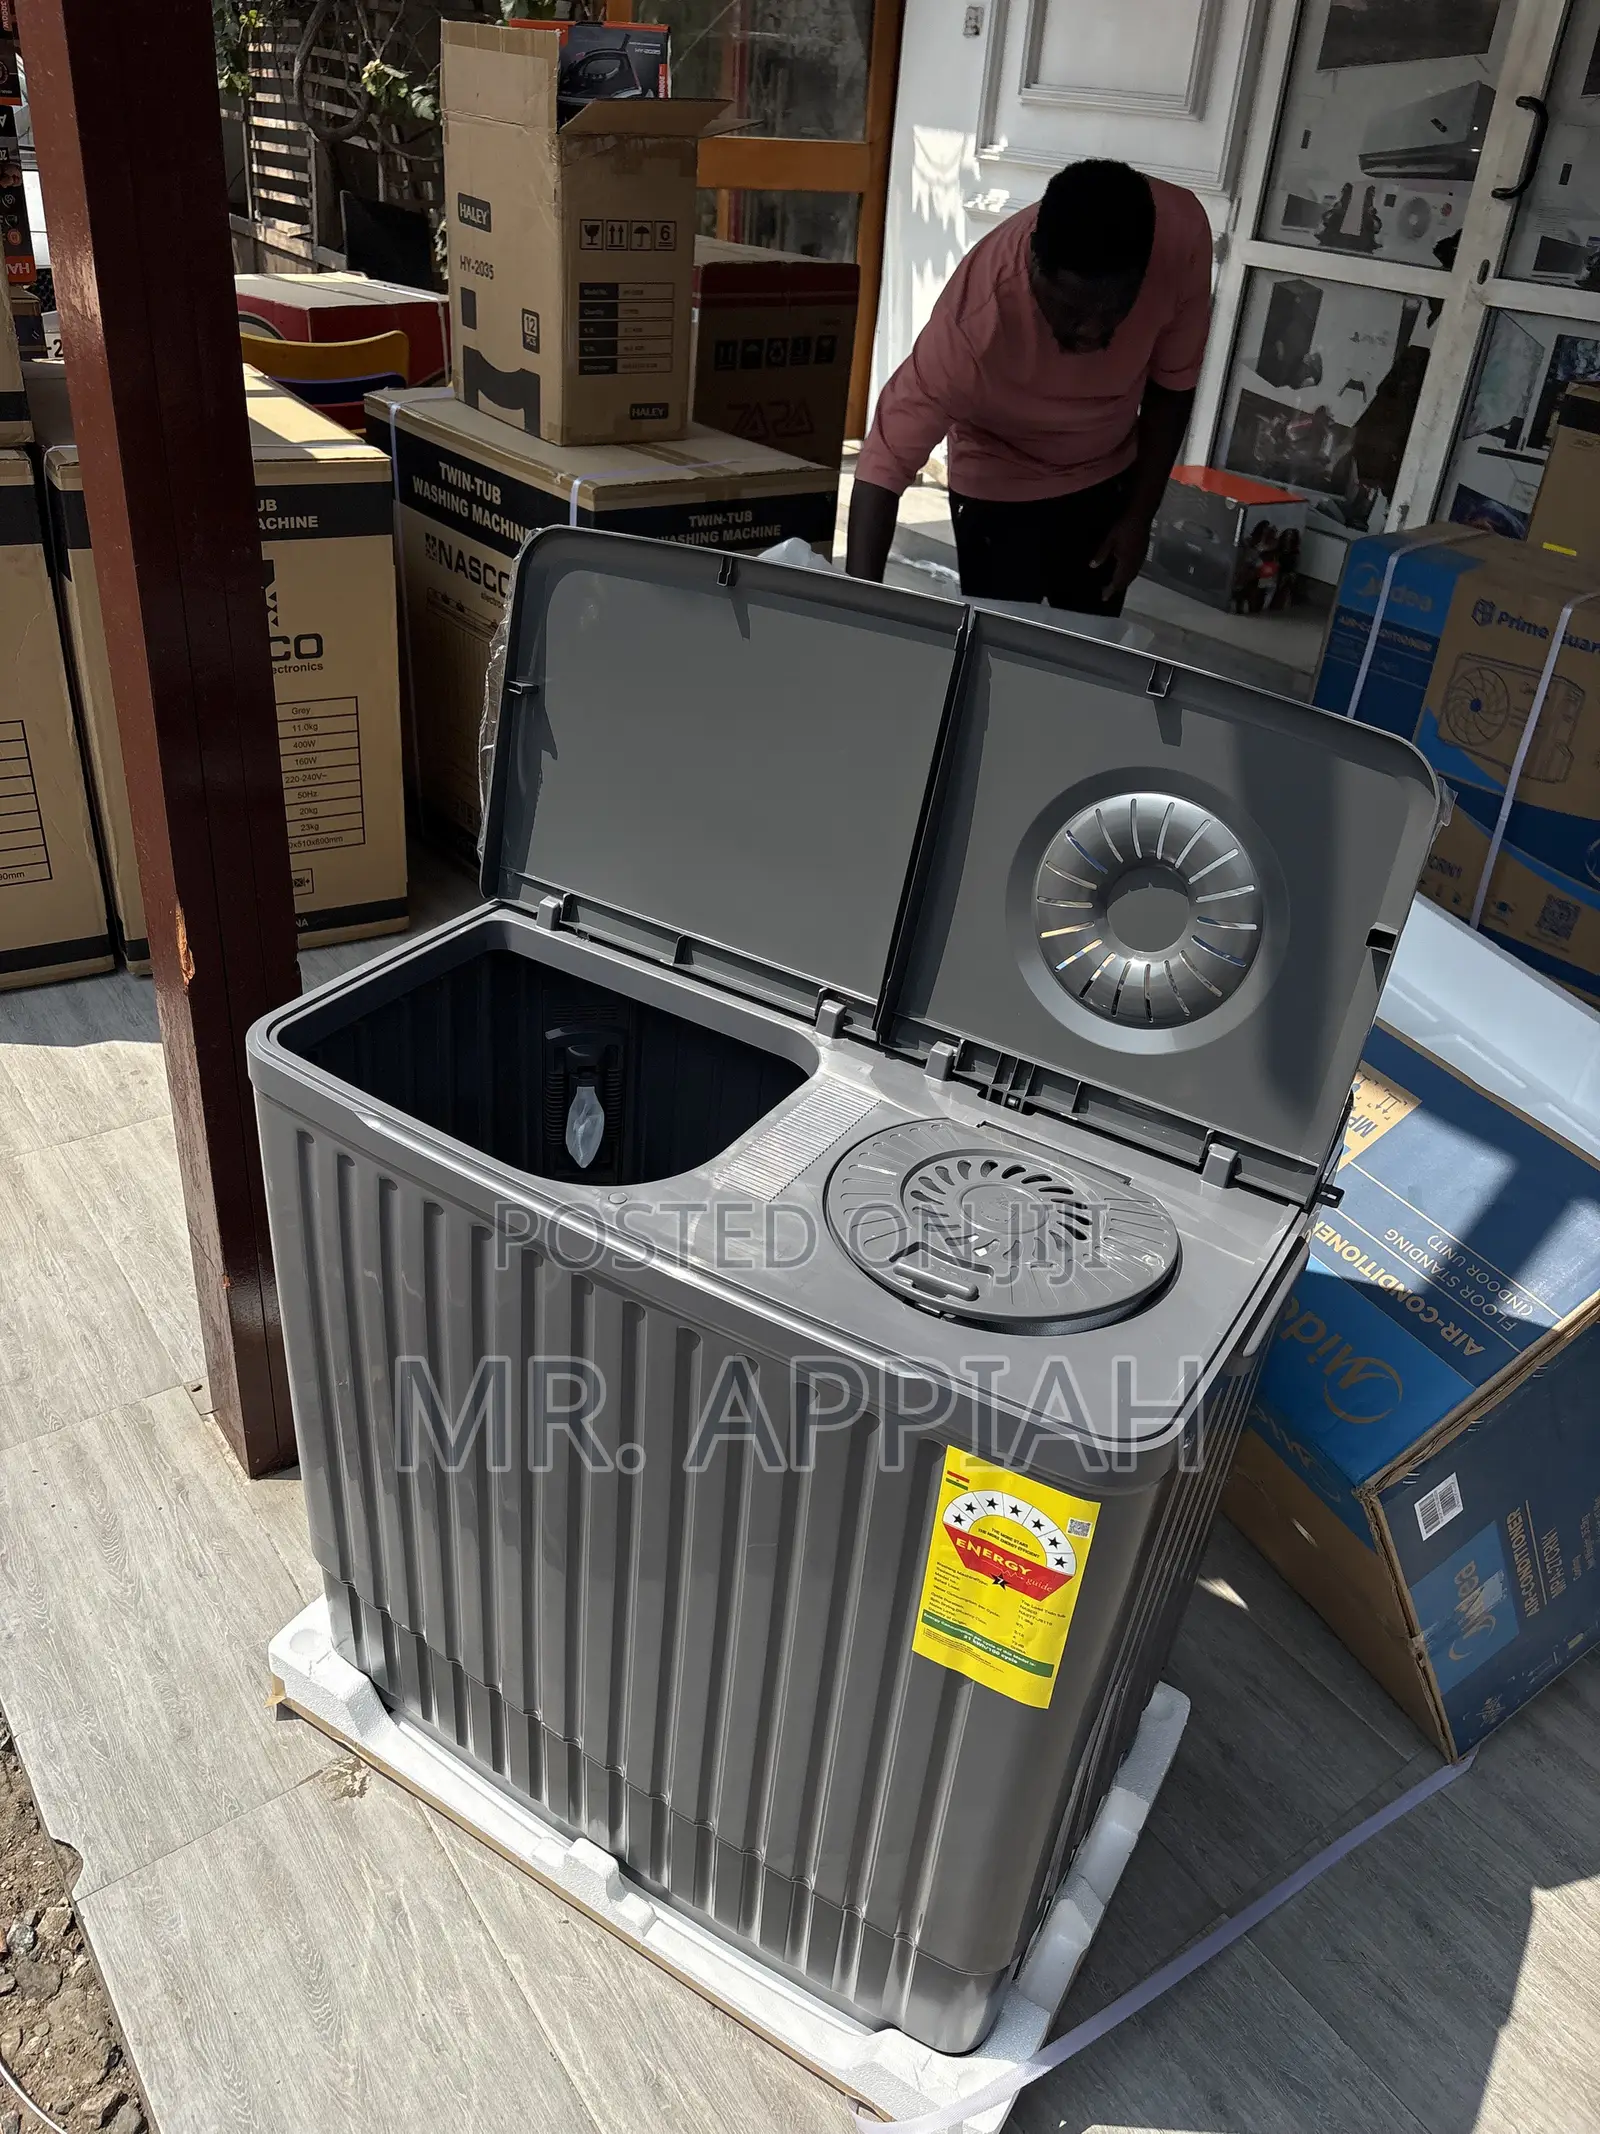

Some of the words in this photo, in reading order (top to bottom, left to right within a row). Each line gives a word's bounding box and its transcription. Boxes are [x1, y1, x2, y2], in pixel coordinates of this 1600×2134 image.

[459, 202, 488, 226] HALEY
[459, 254, 495, 281] HY-2035
[525, 315, 536, 334] 12
[631, 406, 665, 418] HALEY
[438, 460, 502, 505] TWIN-TUB
[412, 475, 469, 518] WASHING
[687, 510, 753, 529] TWIN-TUB
[722, 524, 782, 541] MACHINE
[1497, 610, 1550, 640] Prime
[291, 706, 311, 716] Grey
[292, 722, 319, 733] 11.0kg
[292, 739, 317, 749] 400W
[294, 756, 318, 766] 160W
[297, 790, 319, 800] 50Hz
[299, 806, 319, 816] 20kg
[300, 822, 320, 832] 23kg
[1384, 1228, 1461, 1290] STANDING
[1427, 1235, 1467, 1268] UNIT)
[1466, 1264, 1534, 1317] (INDOOR
[1460, 1285, 1518, 1333] FLOOR
[955, 1537, 1032, 1576] ENERGY
[1506, 1506, 1540, 1618] AIR-CONDITIONER
[1025, 1577, 1053, 1593] guide
